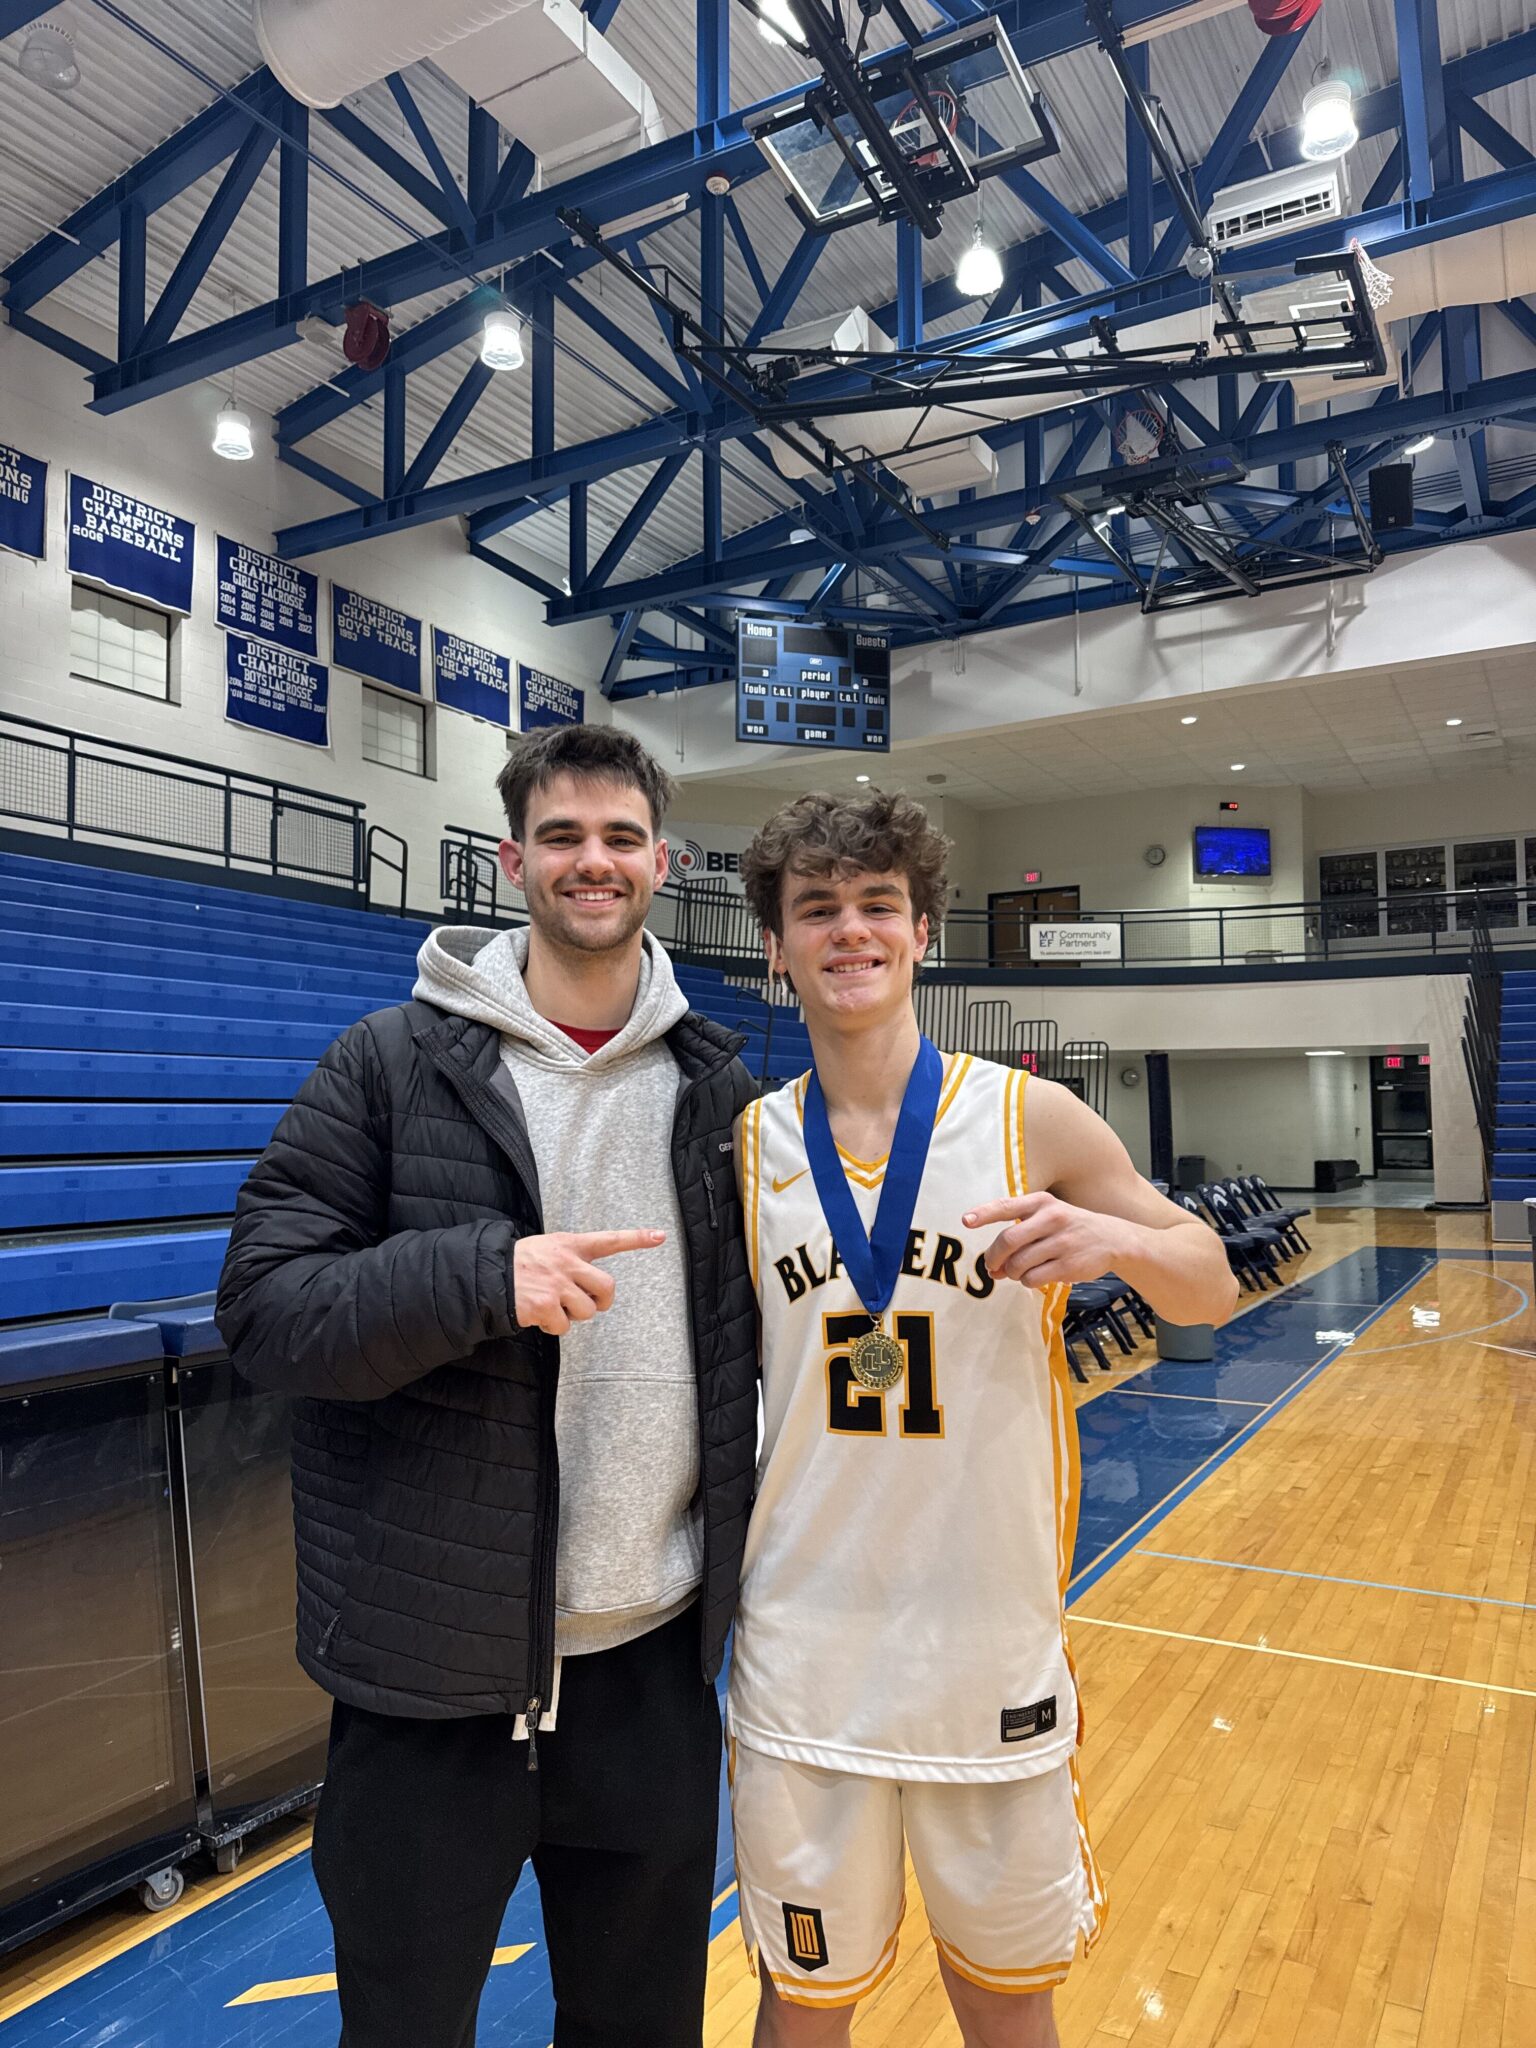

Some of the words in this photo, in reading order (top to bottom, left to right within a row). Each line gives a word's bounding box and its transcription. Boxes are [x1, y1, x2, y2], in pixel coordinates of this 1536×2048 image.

[92, 484, 176, 530] DISTRICT
[72, 525, 104, 543] 2006
[82, 496, 184, 549] CHAMPIONS
[85, 513, 181, 563] BASEBALL
[229, 556, 307, 599] CHAMPIONS
[237, 545, 300, 582] DISTRICT
[220, 593, 236, 606] 2014
[241, 600, 256, 613] 2015
[232, 571, 259, 593] GIRLS
[261, 583, 305, 611] LACROSSE
[342, 603, 414, 642] CHAMPIONS
[348, 592, 407, 627] DISTRICT
[337, 614, 371, 638] BOYS
[376, 630, 417, 657] TRACK
[747, 623, 773, 637] Home
[856, 633, 887, 648] Guests
[247, 641, 310, 674] DISTRICT
[442, 645, 503, 679] CHAMPIONS
[448, 635, 497, 665] DISTRICT
[237, 653, 318, 690] CHAMPIONS
[244, 667, 268, 687] BOYS
[268, 676, 313, 702] LACROSSE
[436, 654, 469, 677] GIRLS
[473, 669, 508, 693] TRACK
[531, 670, 574, 697] DISTRICT
[801, 669, 831, 682] period
[525, 679, 578, 710] CHAMPIONS
[744, 683, 766, 695] fouls
[801, 686, 831, 701] player
[864, 694, 886, 705] fouls
[528, 691, 576, 720] SOFTBALL
[746, 725, 764, 734] won
[804, 728, 828, 740] game
[866, 734, 883, 744] won
[706, 851, 743, 873] BE
[1039, 930, 1057, 939] MT
[1059, 930, 1112, 940] Community
[773, 1228, 996, 1304] BLERS
[822, 1310, 945, 1439] 21
[1041, 1708, 1052, 1722] M
